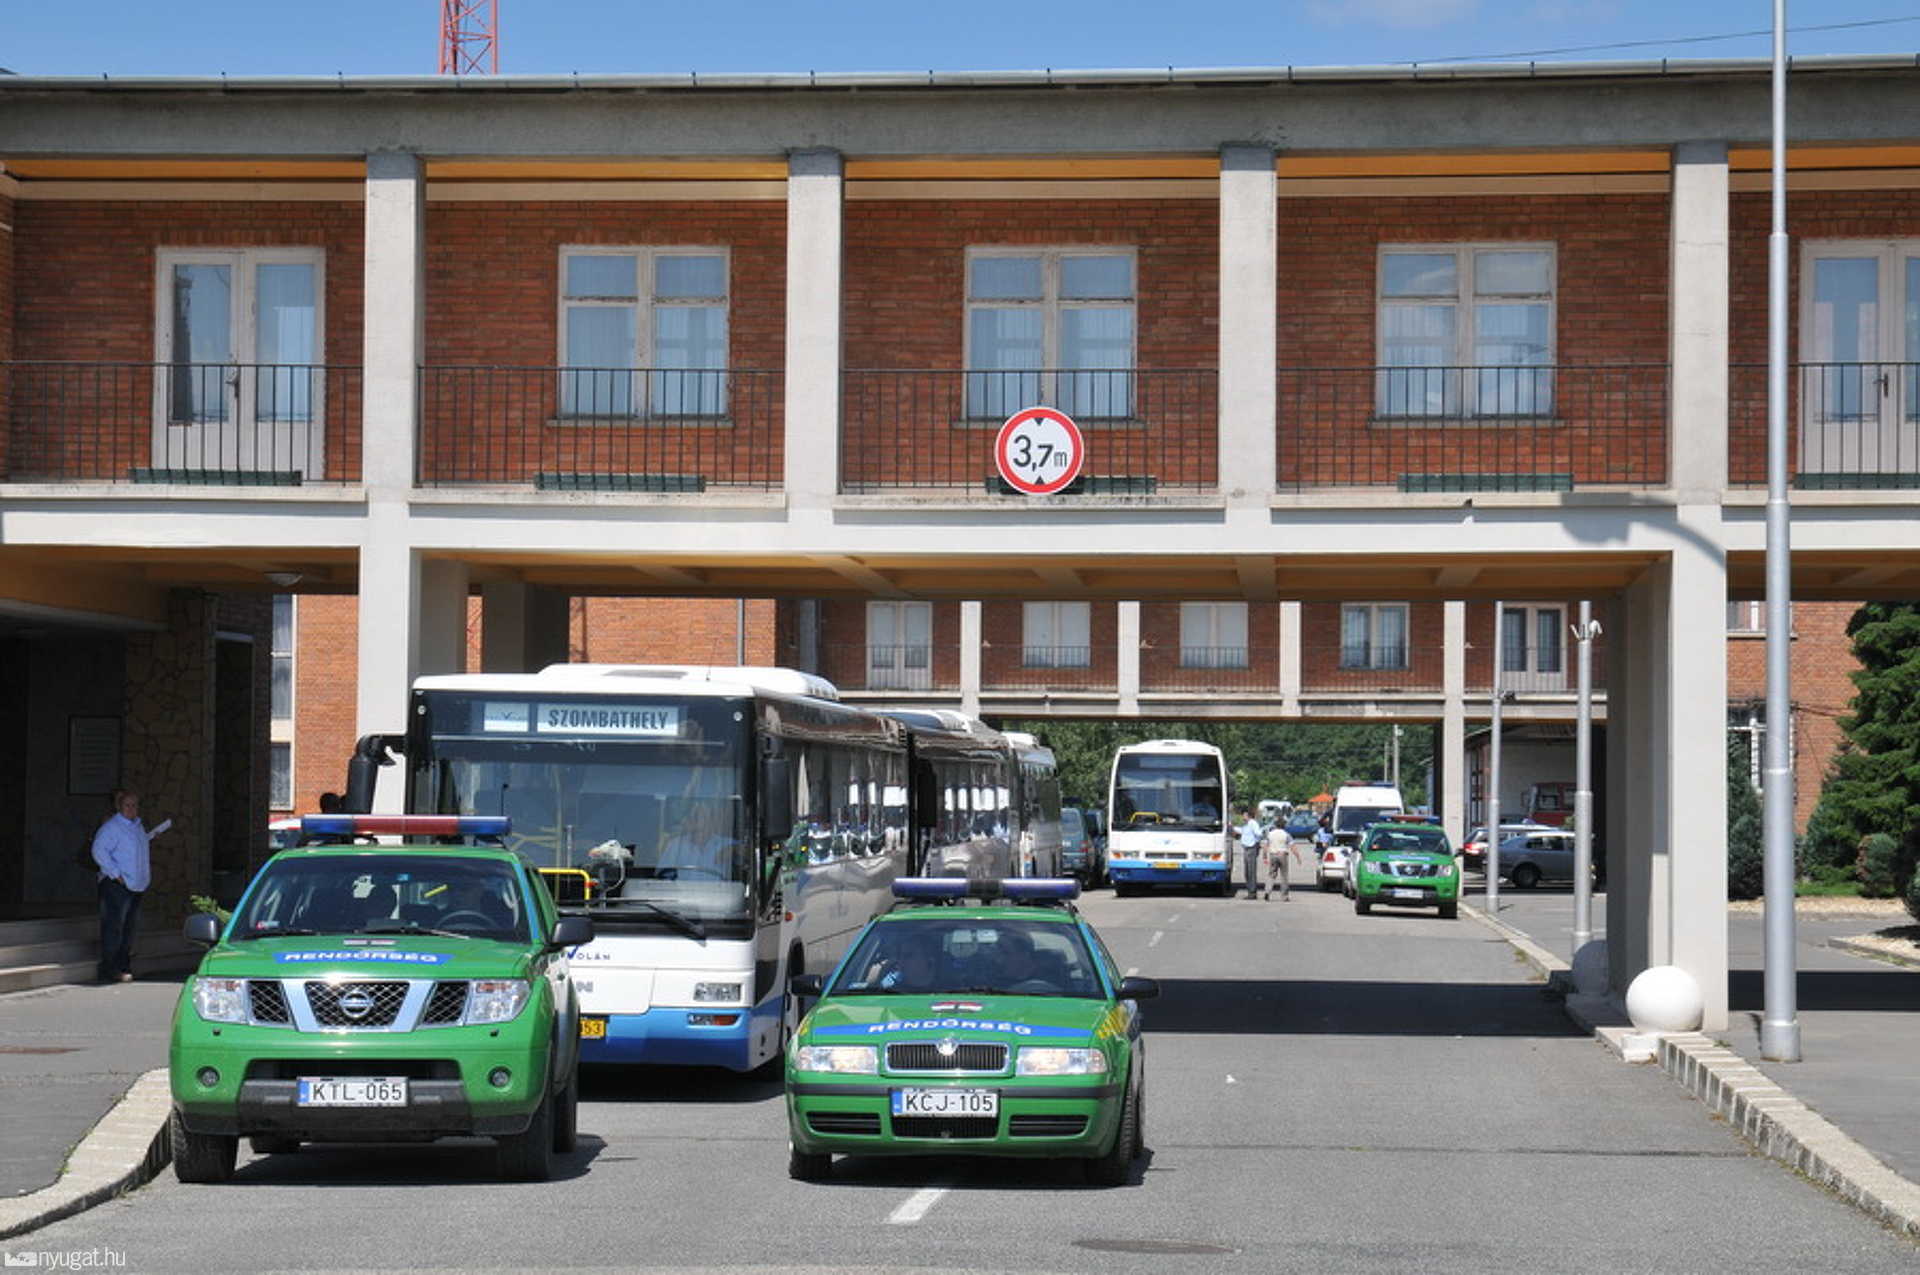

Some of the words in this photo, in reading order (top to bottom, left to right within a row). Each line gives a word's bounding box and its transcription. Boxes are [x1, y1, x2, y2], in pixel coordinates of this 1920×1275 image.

[548, 709, 669, 730] SZOMBATHELY
[313, 1083, 402, 1101] KTL-065
[905, 1094, 993, 1112] KCJ-105
